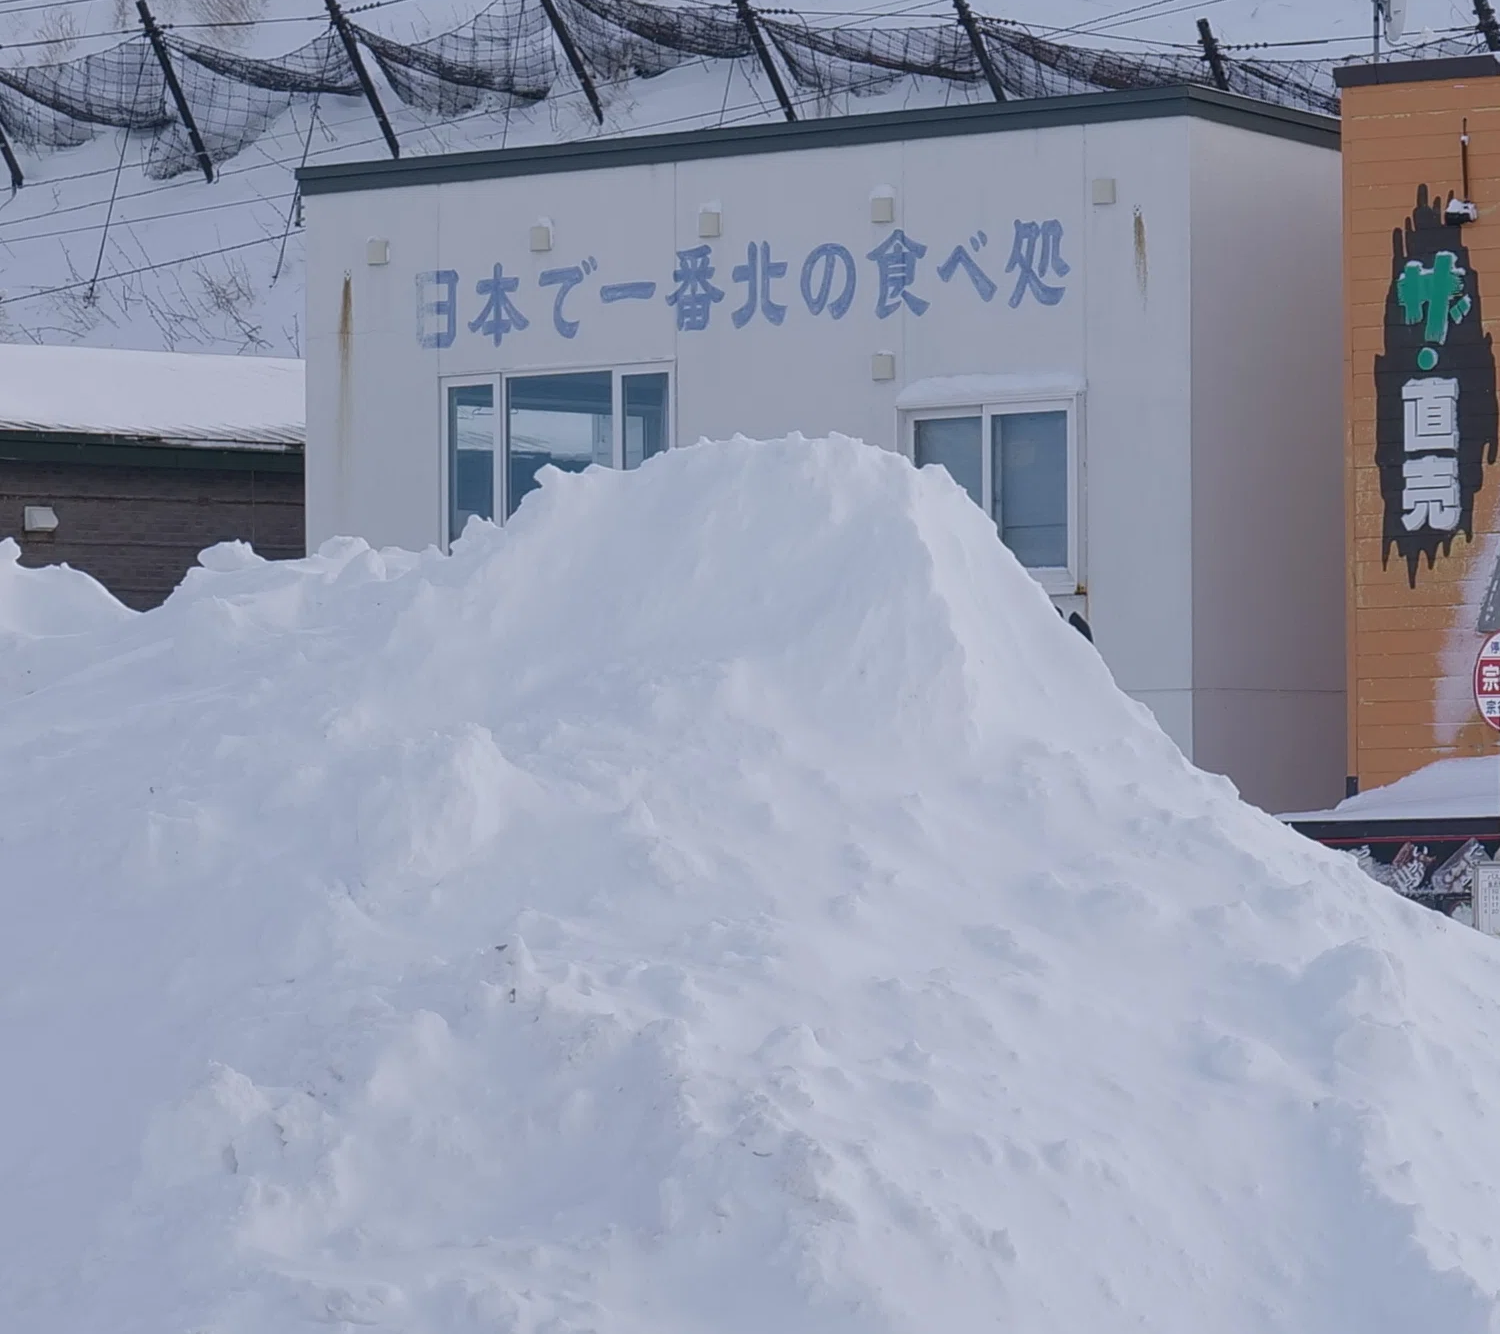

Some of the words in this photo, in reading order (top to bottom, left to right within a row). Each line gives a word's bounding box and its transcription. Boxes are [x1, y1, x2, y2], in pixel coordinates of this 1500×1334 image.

[416, 217, 1071, 349] 日本で一番北の食べ処
